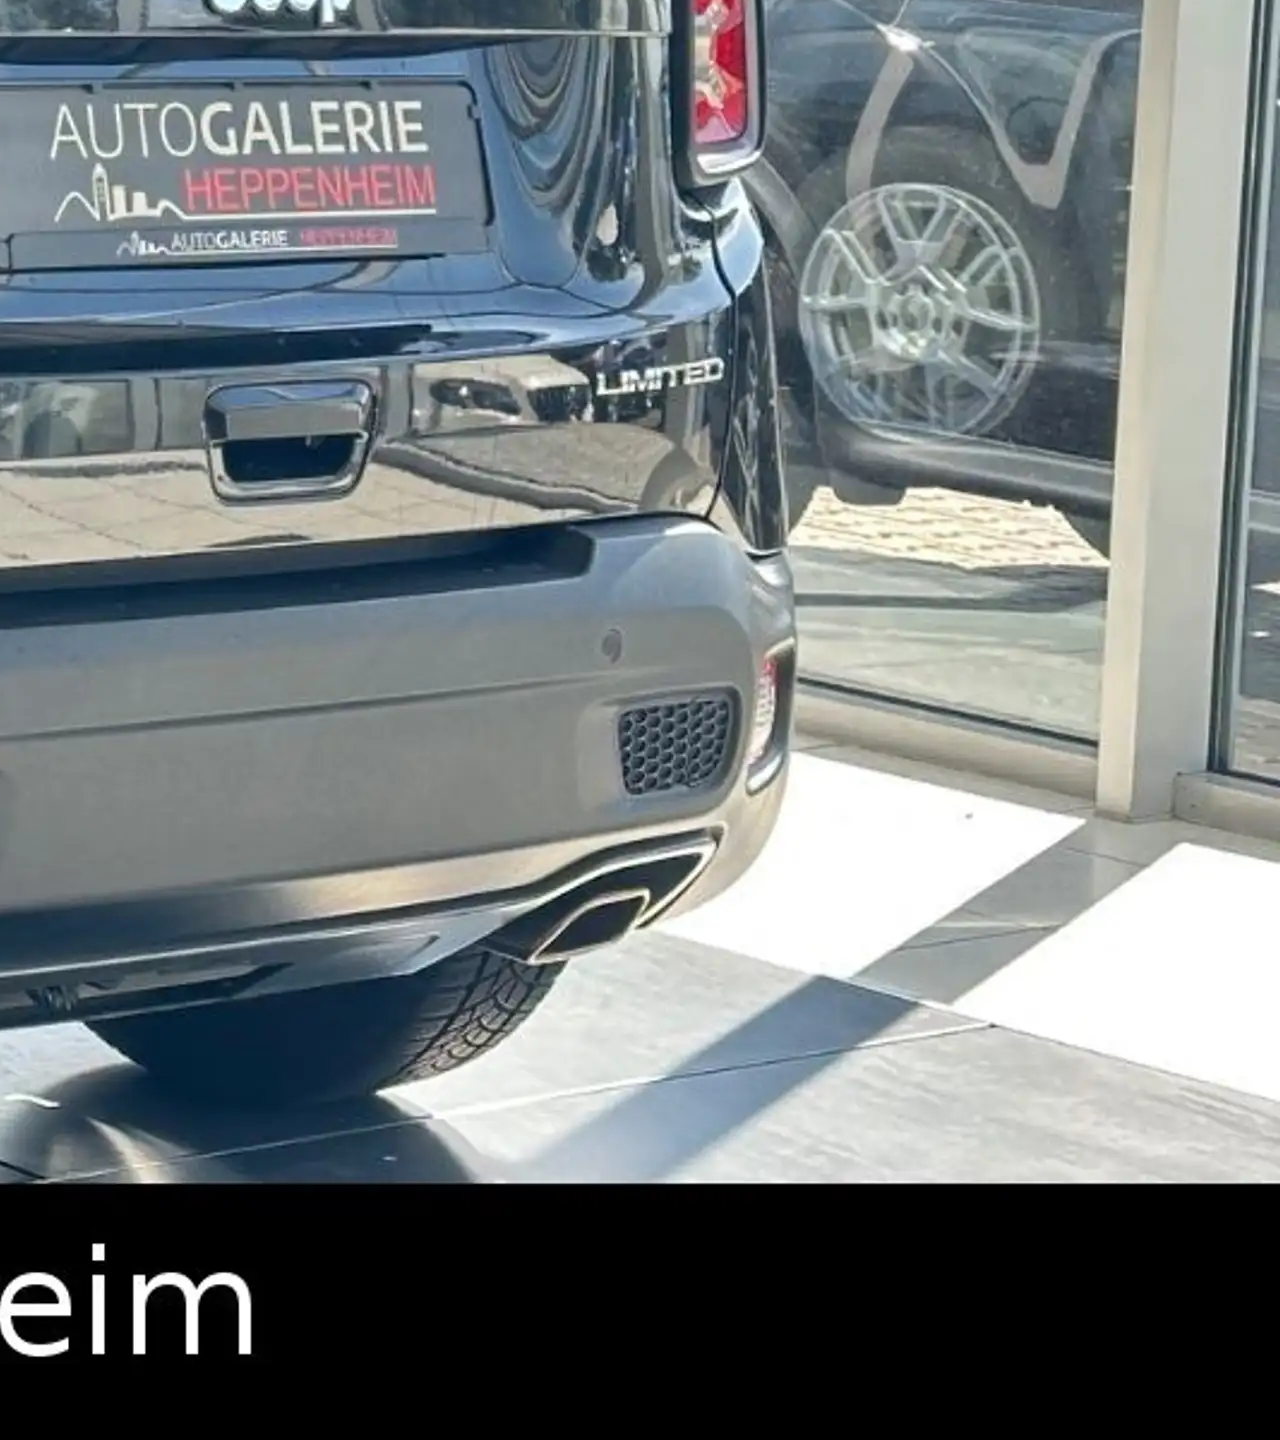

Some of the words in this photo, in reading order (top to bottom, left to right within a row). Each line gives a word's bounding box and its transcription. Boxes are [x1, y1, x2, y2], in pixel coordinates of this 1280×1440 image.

[51, 100, 429, 159] AUTOGALERIE
[184, 164, 437, 211] HEPPENHEIM
[170, 230, 289, 252] AUTOGALERIE
[596, 358, 725, 396] LIMITED
